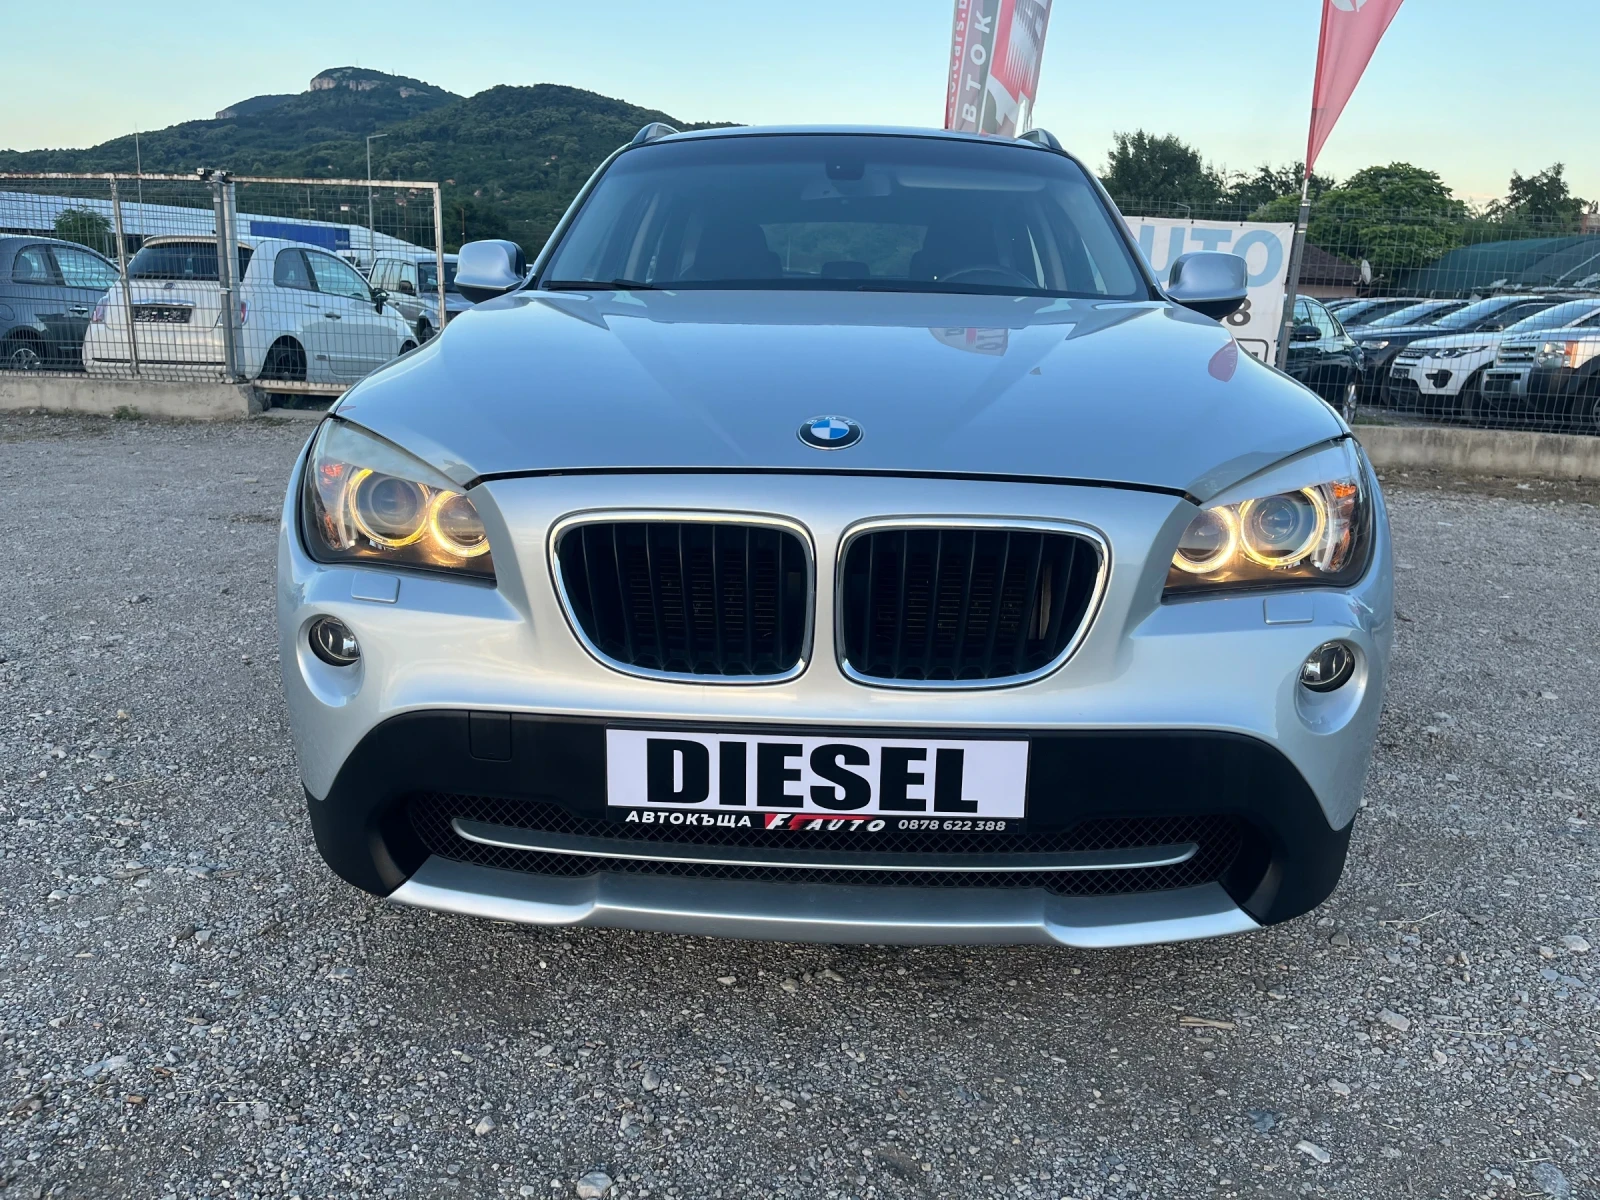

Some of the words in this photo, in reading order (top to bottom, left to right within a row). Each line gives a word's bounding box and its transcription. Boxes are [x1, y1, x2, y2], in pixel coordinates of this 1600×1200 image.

[646, 738, 979, 813] DIESEL
[625, 811, 752, 828] АВТОКЪЩА
[805, 818, 886, 832] AUTO
[898, 819, 939, 830] 0878
[943, 820, 972, 831] 622
[975, 821, 1006, 831] 388
